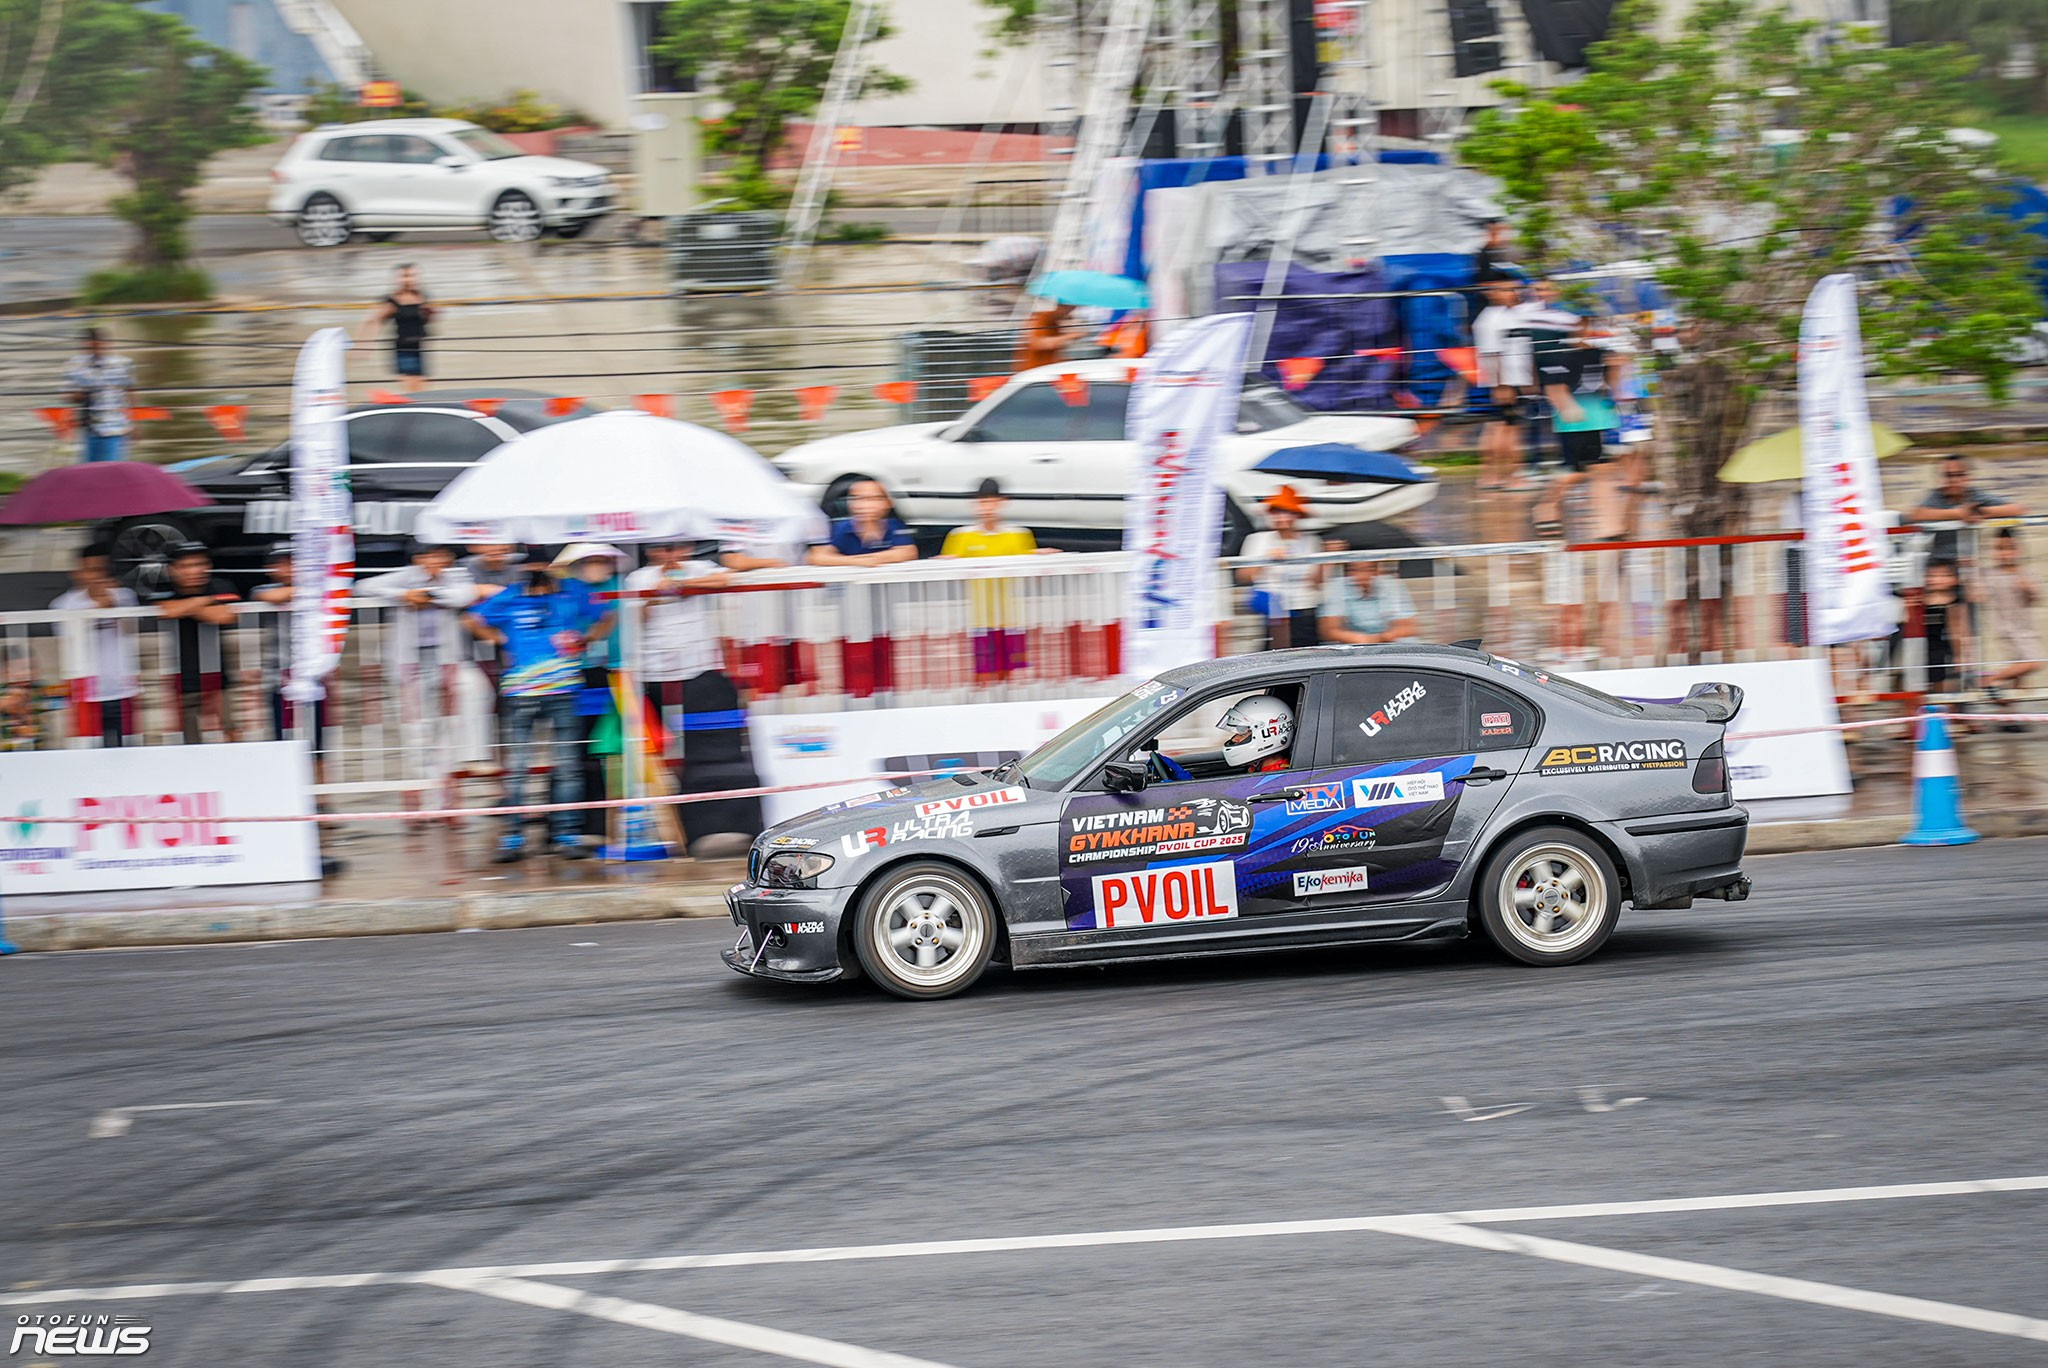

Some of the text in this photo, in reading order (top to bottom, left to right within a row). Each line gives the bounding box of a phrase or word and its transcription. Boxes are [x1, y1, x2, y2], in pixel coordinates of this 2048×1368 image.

[1384, 681, 1423, 711] ULTRA
[1388, 686, 1427, 721] RACING
[1542, 741, 1685, 767] BC RACING
[1542, 766, 1587, 776] EXCLUSIVELY
[1588, 763, 1630, 772] DISTRIBUTED
[1641, 760, 1685, 769] VIETPASSION
[922, 790, 1018, 816] PVOIL
[1291, 798, 1342, 811] MEDIA
[1303, 785, 1340, 801] TV
[890, 821, 974, 845] RACING
[894, 811, 970, 833] ULTRA
[1071, 808, 1165, 832] VIETNAM
[840, 826, 888, 858] UR
[1069, 821, 1196, 852] GYMKHANA
[1068, 836, 1244, 864] CHAMPIONSHIP PVOIL CUP 2025
[1297, 871, 1364, 892] Ekokemika
[1101, 867, 1229, 928] PVOIL
